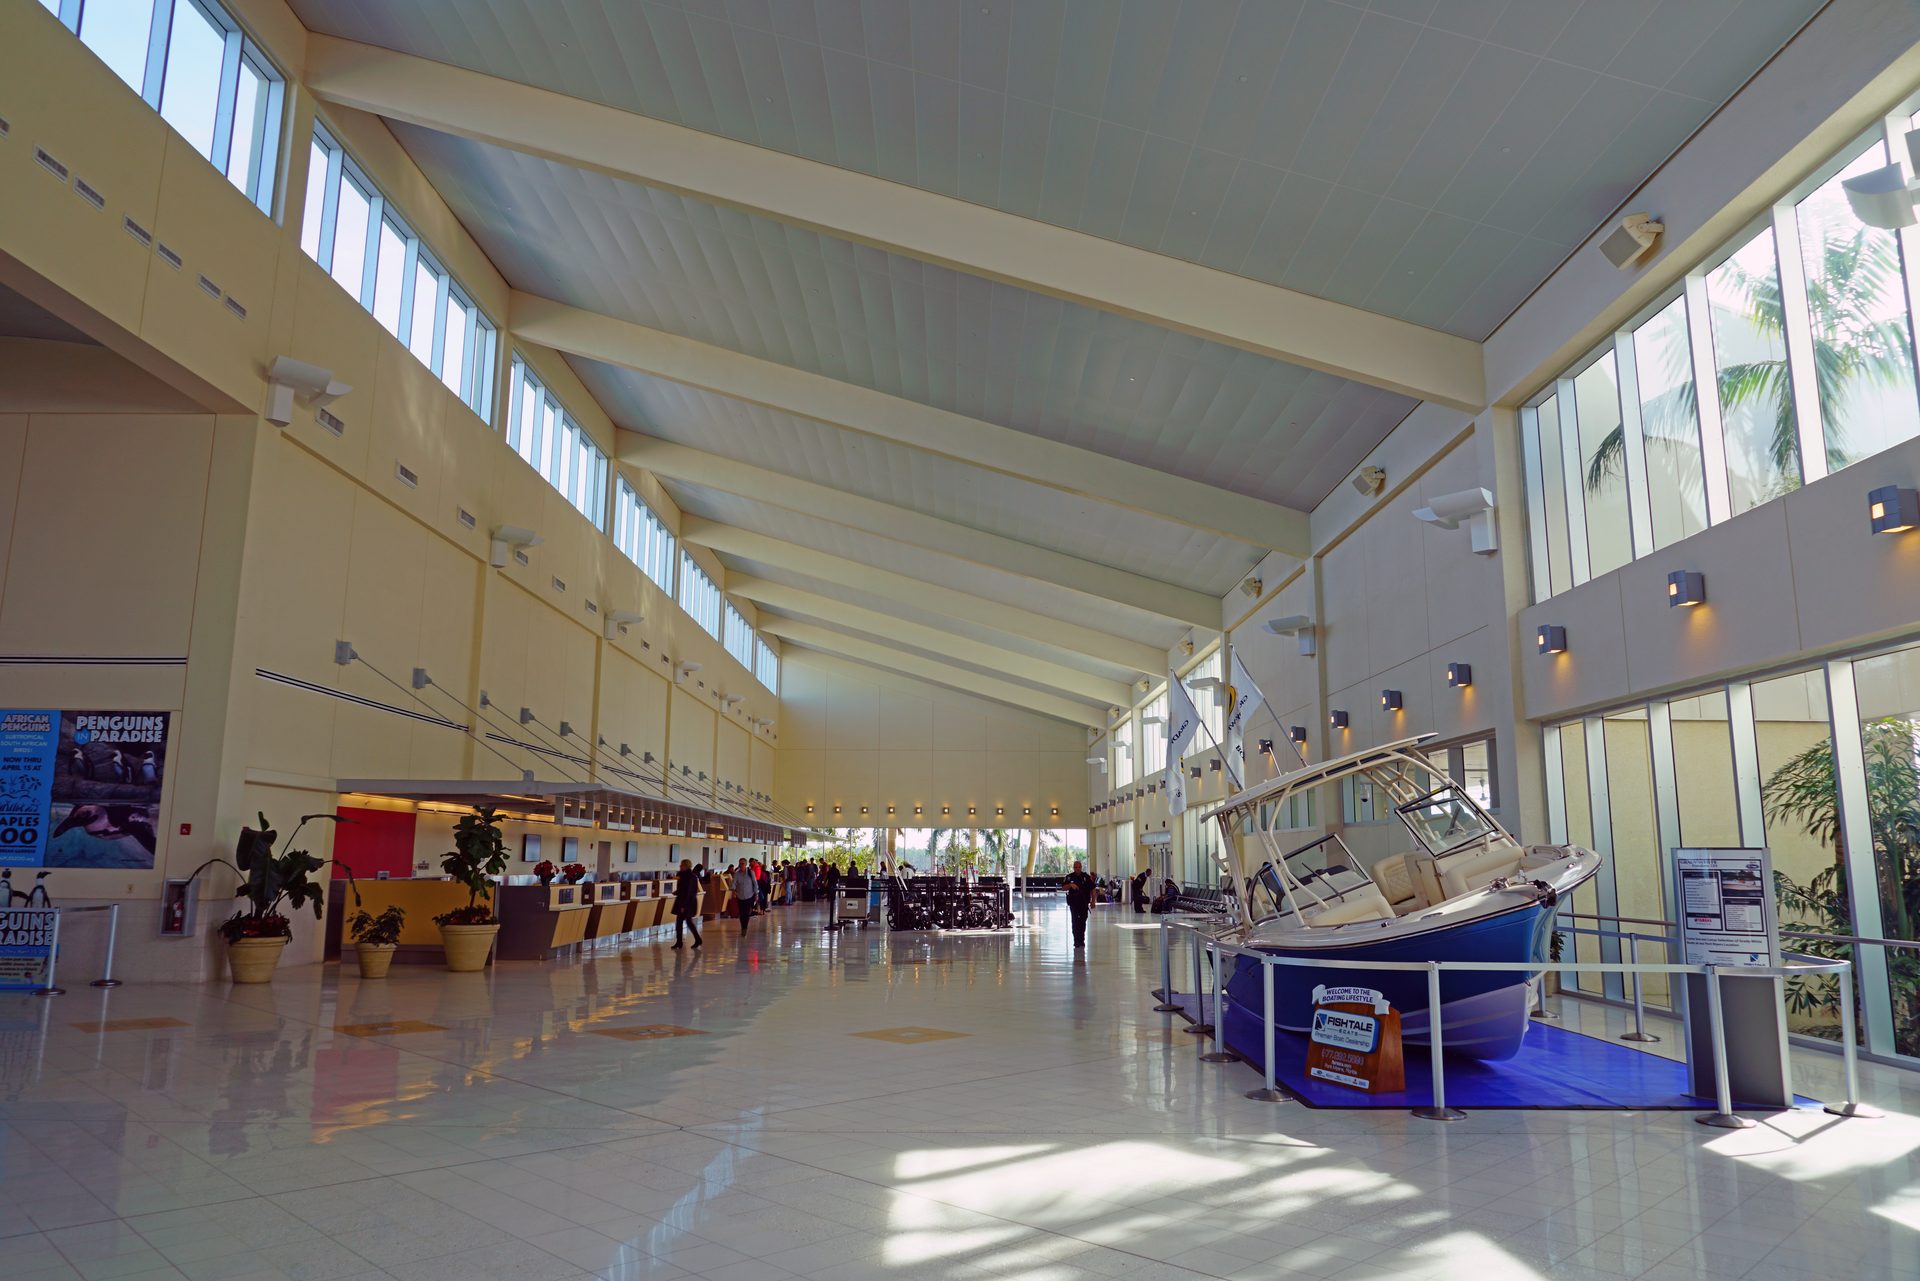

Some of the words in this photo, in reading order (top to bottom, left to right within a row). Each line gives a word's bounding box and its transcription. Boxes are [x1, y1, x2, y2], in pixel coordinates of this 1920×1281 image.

[5, 714, 49, 723] AFRICAN
[76, 716, 164, 730] PENGUINS
[0, 723, 51, 732] PENGUINS
[77, 732, 89, 740] IN
[90, 730, 162, 743] PARADISE
[0, 816, 39, 826] APLES
[0, 828, 38, 844] OO
[0, 912, 54, 930] GUINS
[1346, 995, 1374, 1003] LIFESTYLE
